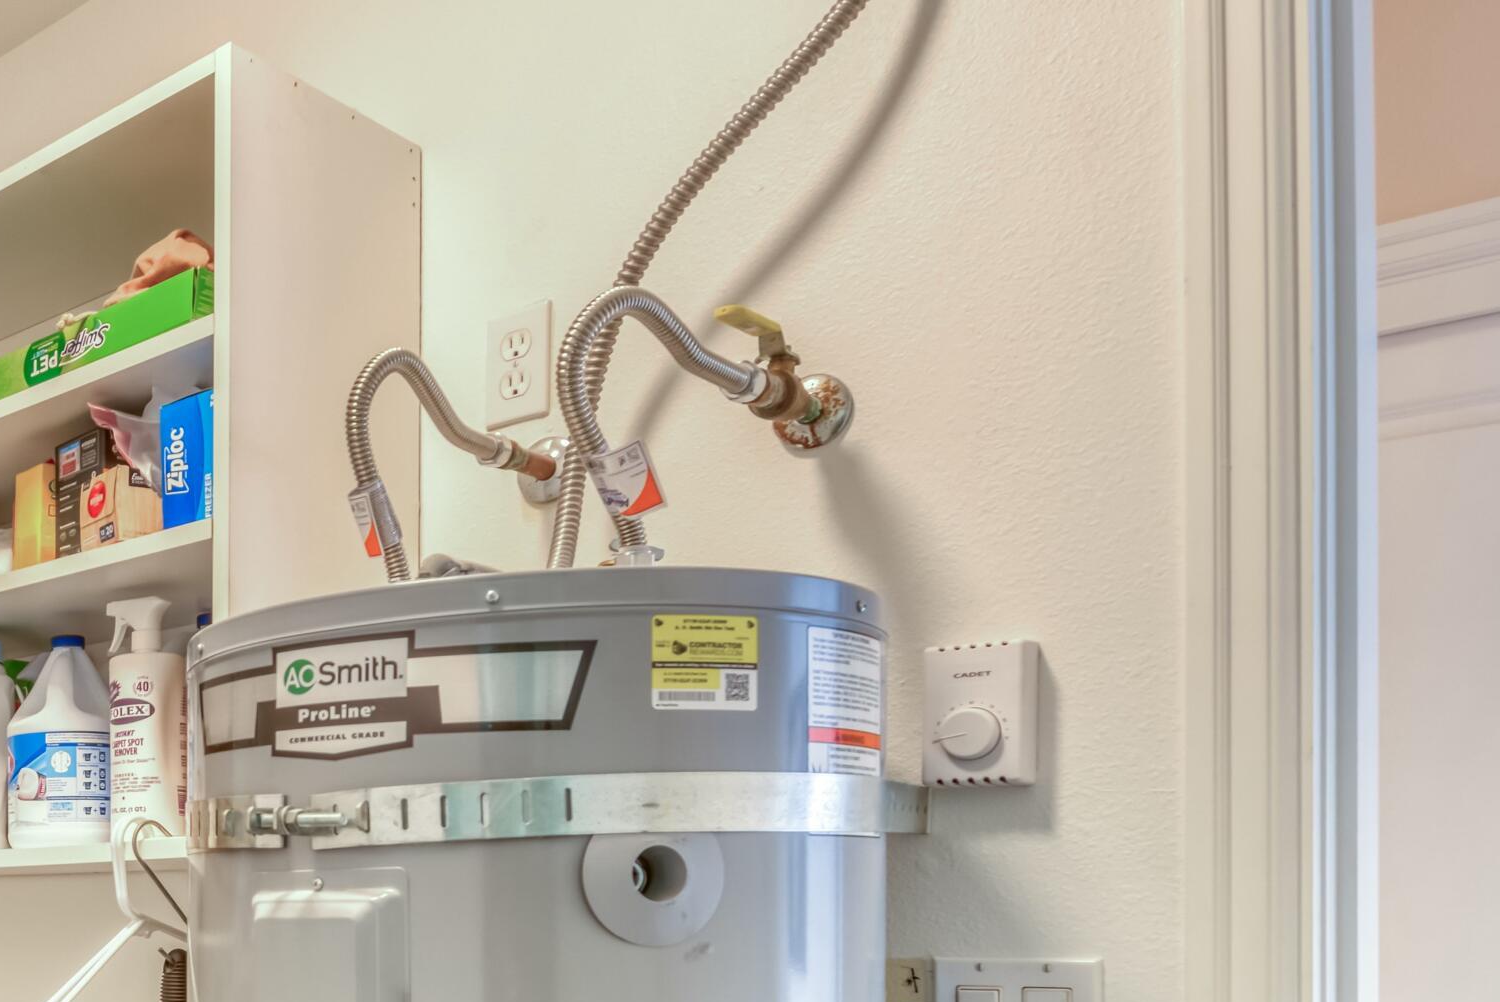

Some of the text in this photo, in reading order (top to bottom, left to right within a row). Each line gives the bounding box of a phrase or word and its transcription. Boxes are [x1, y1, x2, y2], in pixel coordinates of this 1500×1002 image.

[61, 324, 110, 357] Swiffer
[30, 350, 59, 377] PET
[167, 427, 189, 492] Ziploc
[689, 641, 743, 649] CONTRACTOR
[953, 670, 992, 679] CADET
[135, 681, 149, 692] 40
[111, 705, 146, 718] OLEX
[297, 704, 372, 723] ProLine
[128, 738, 144, 747] SPOT
[289, 731, 385, 744] COMMERCIAL GRADE
